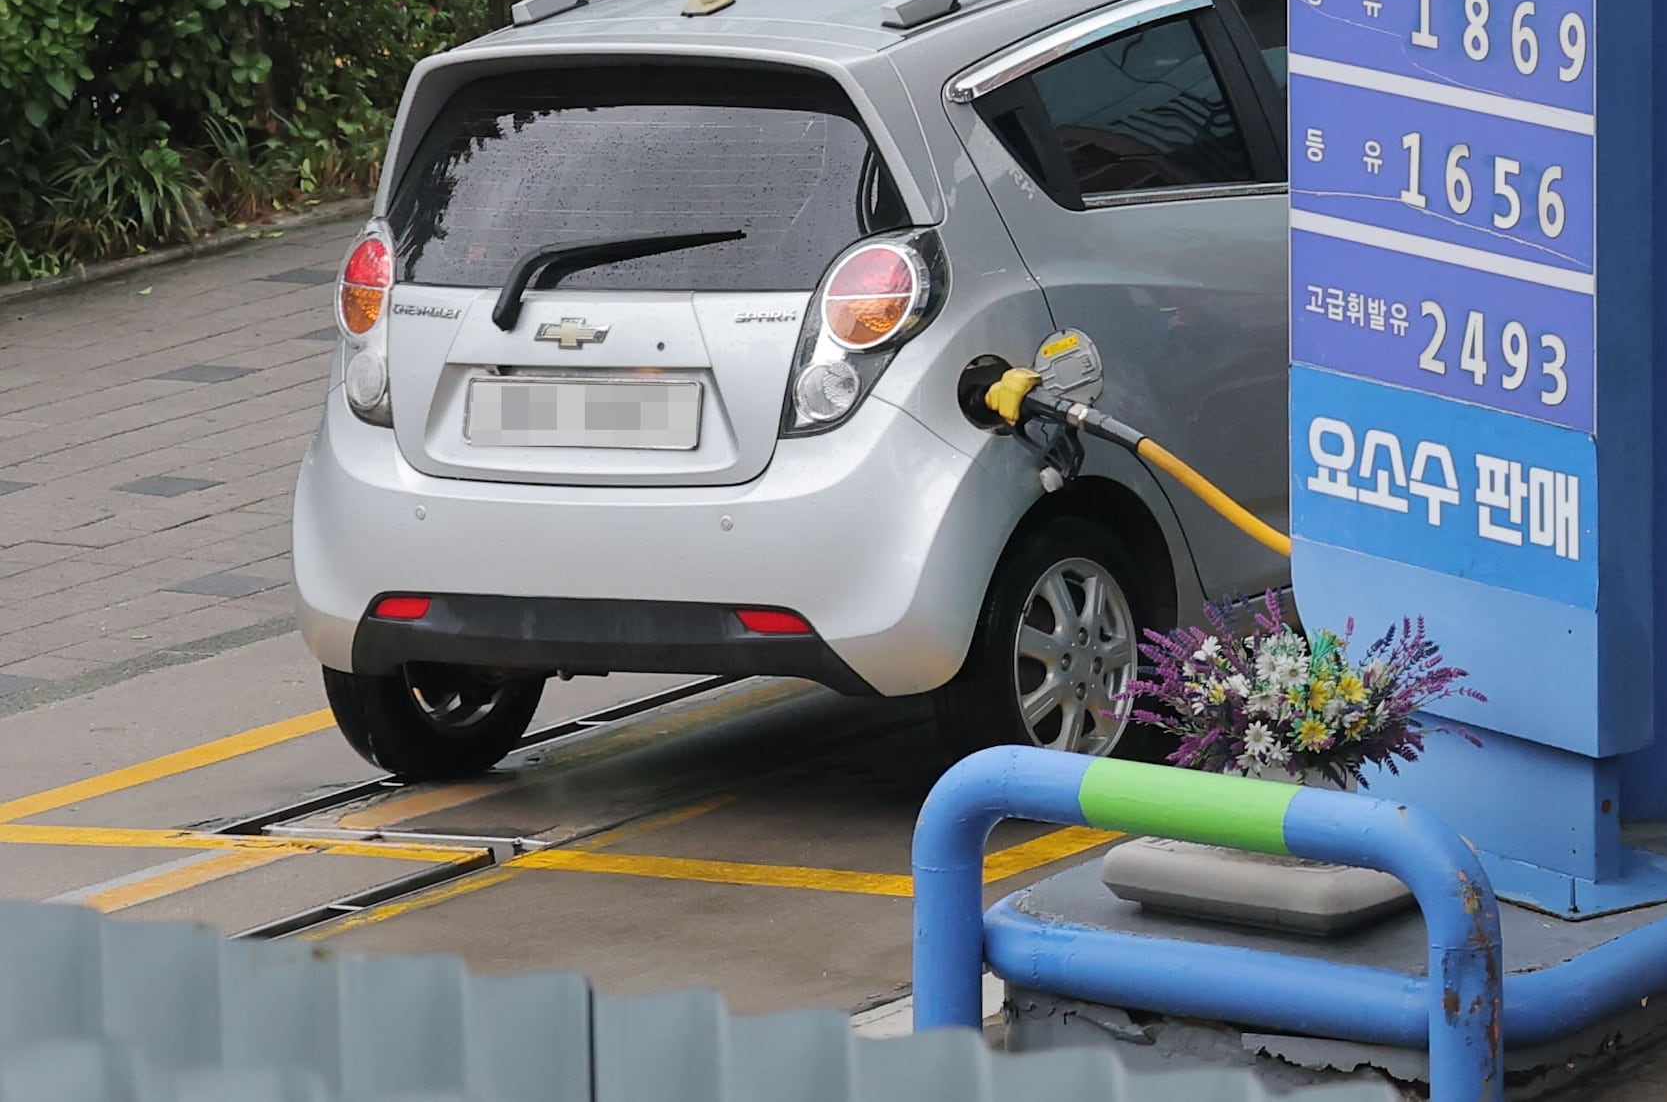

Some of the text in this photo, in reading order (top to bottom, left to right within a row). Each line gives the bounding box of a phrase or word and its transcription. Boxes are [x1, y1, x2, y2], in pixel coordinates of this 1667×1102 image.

[1400, 131, 1567, 239] 1656
[392, 303, 462, 320] CHEVROLET
[735, 309, 797, 324] SPARK
[1304, 283, 1569, 406] 고급휘발유 2493
[1307, 416, 1581, 562] 요소수 판매
